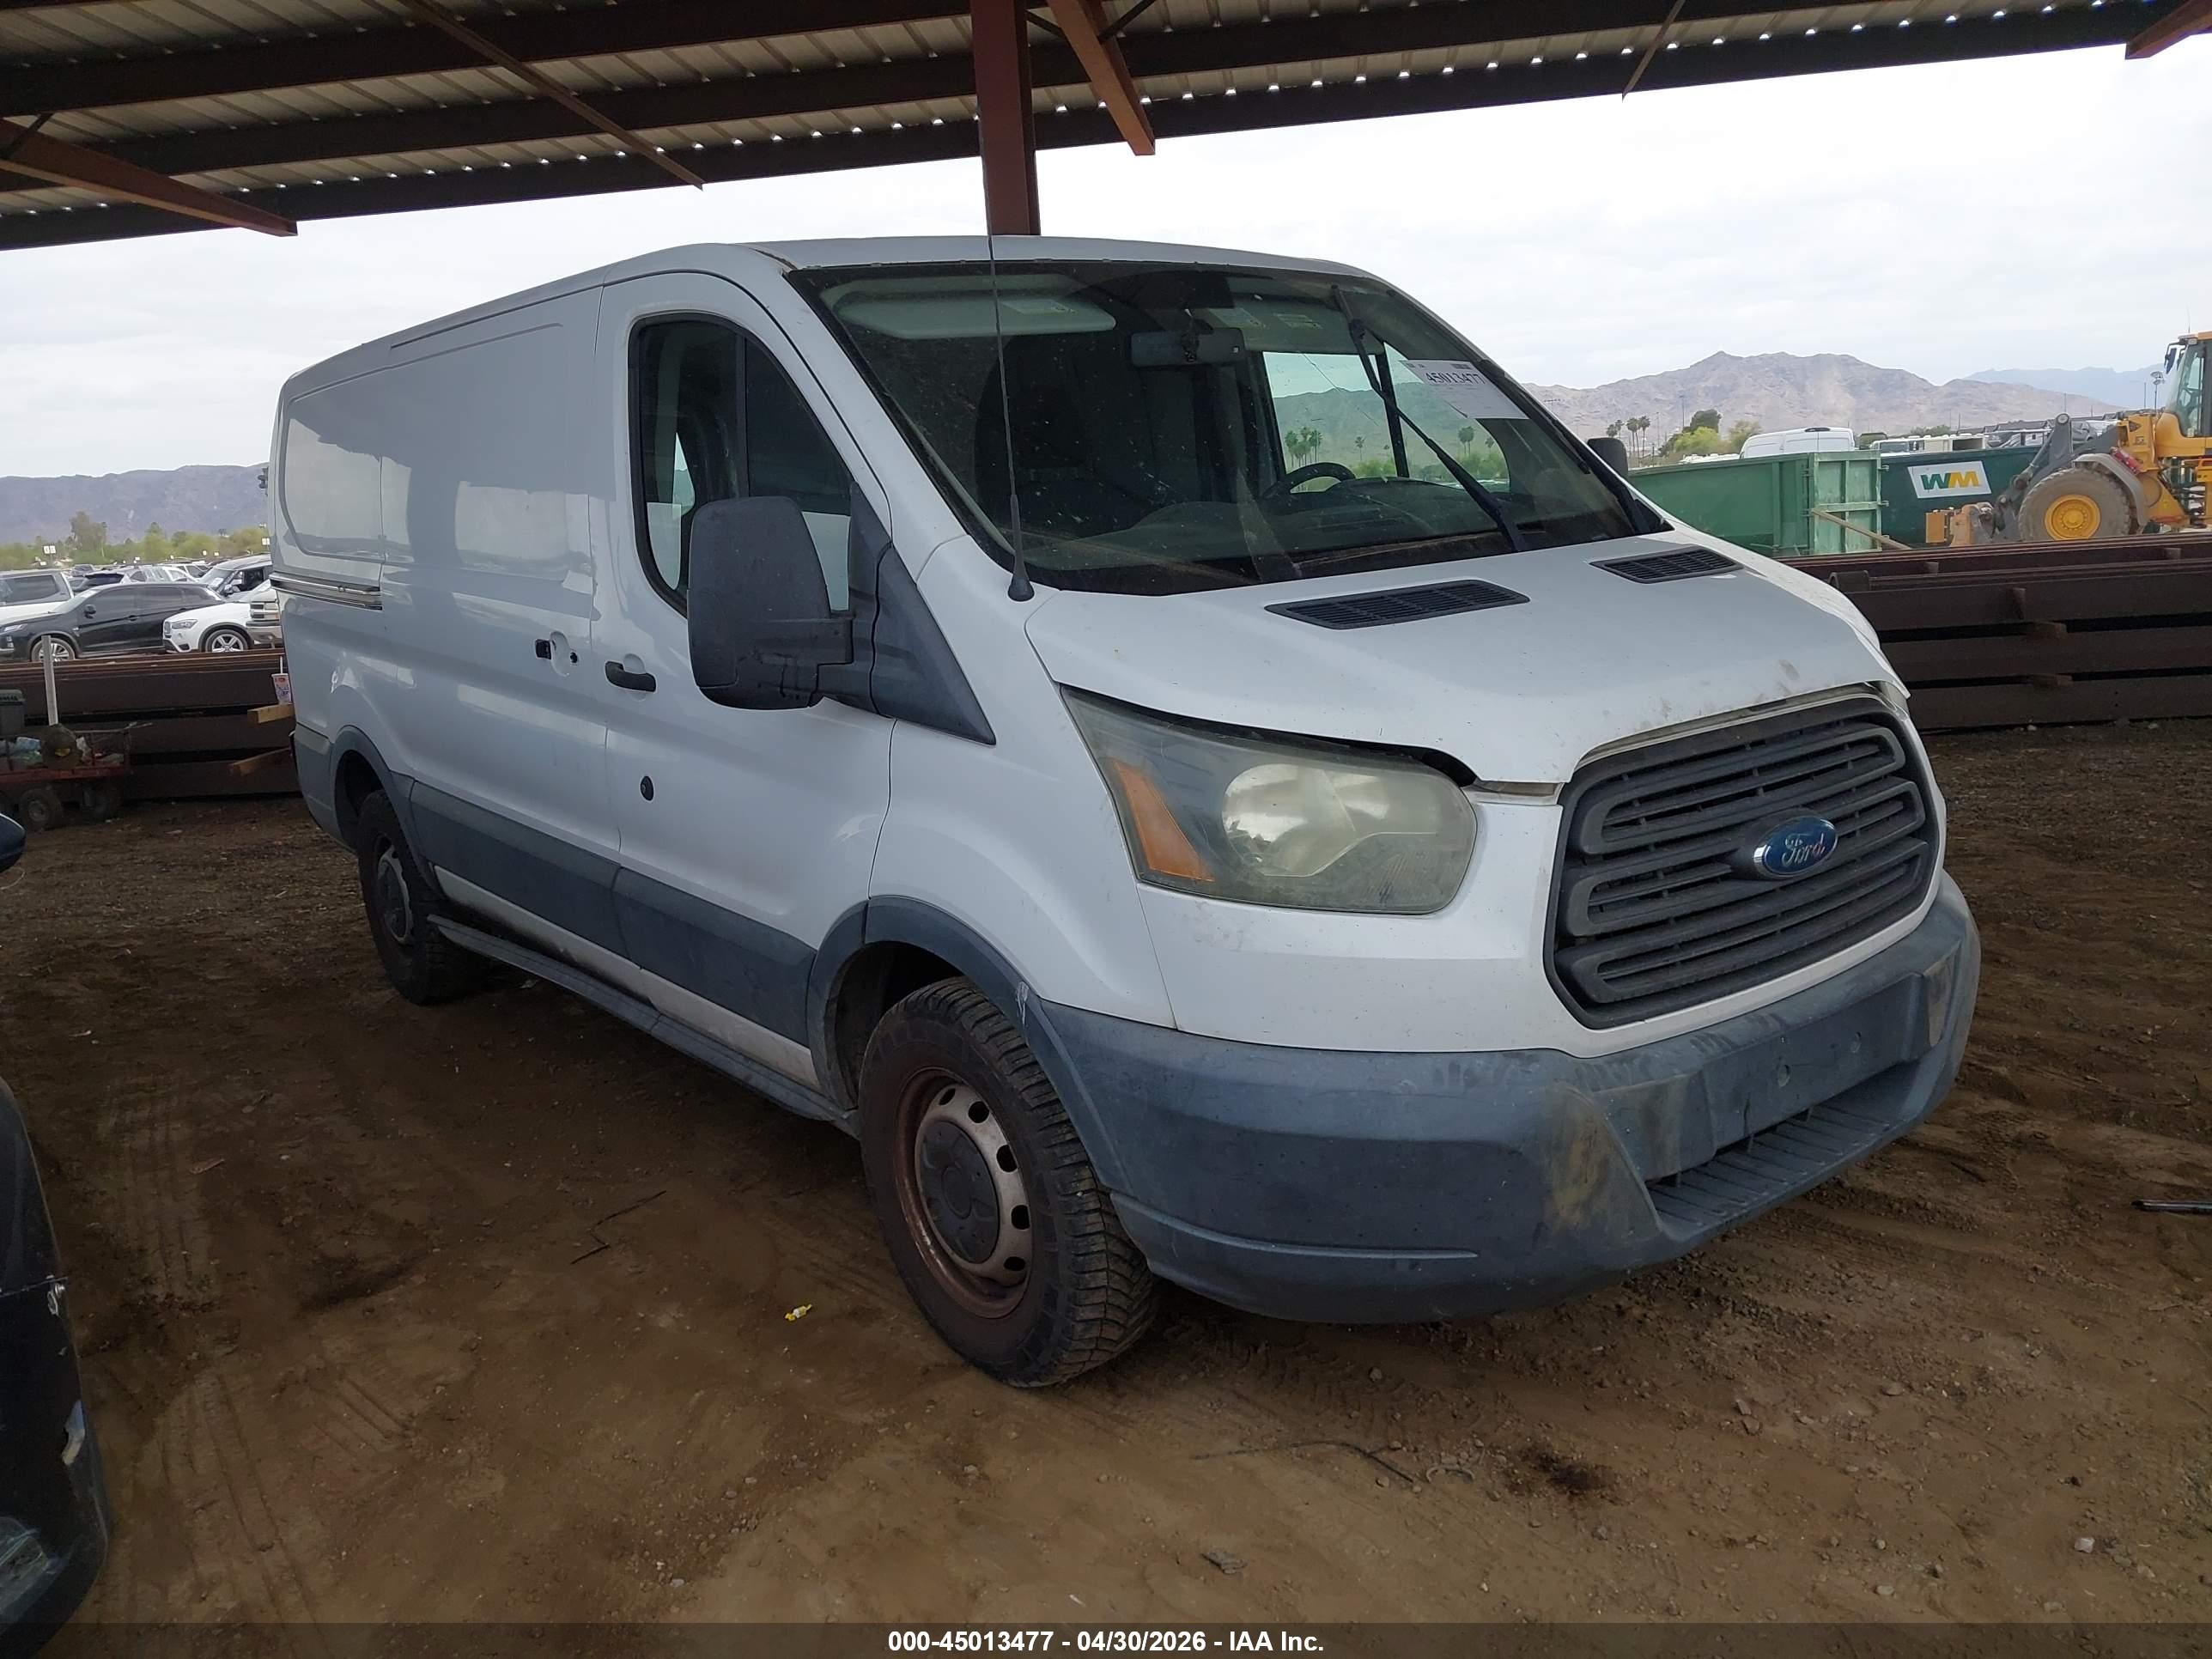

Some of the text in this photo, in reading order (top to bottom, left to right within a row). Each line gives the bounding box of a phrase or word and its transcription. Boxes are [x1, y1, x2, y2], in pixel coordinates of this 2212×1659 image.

[1425, 372, 1486, 385] 45013477
[1921, 471, 1979, 489] WM
[1782, 832, 1826, 867] Ford
